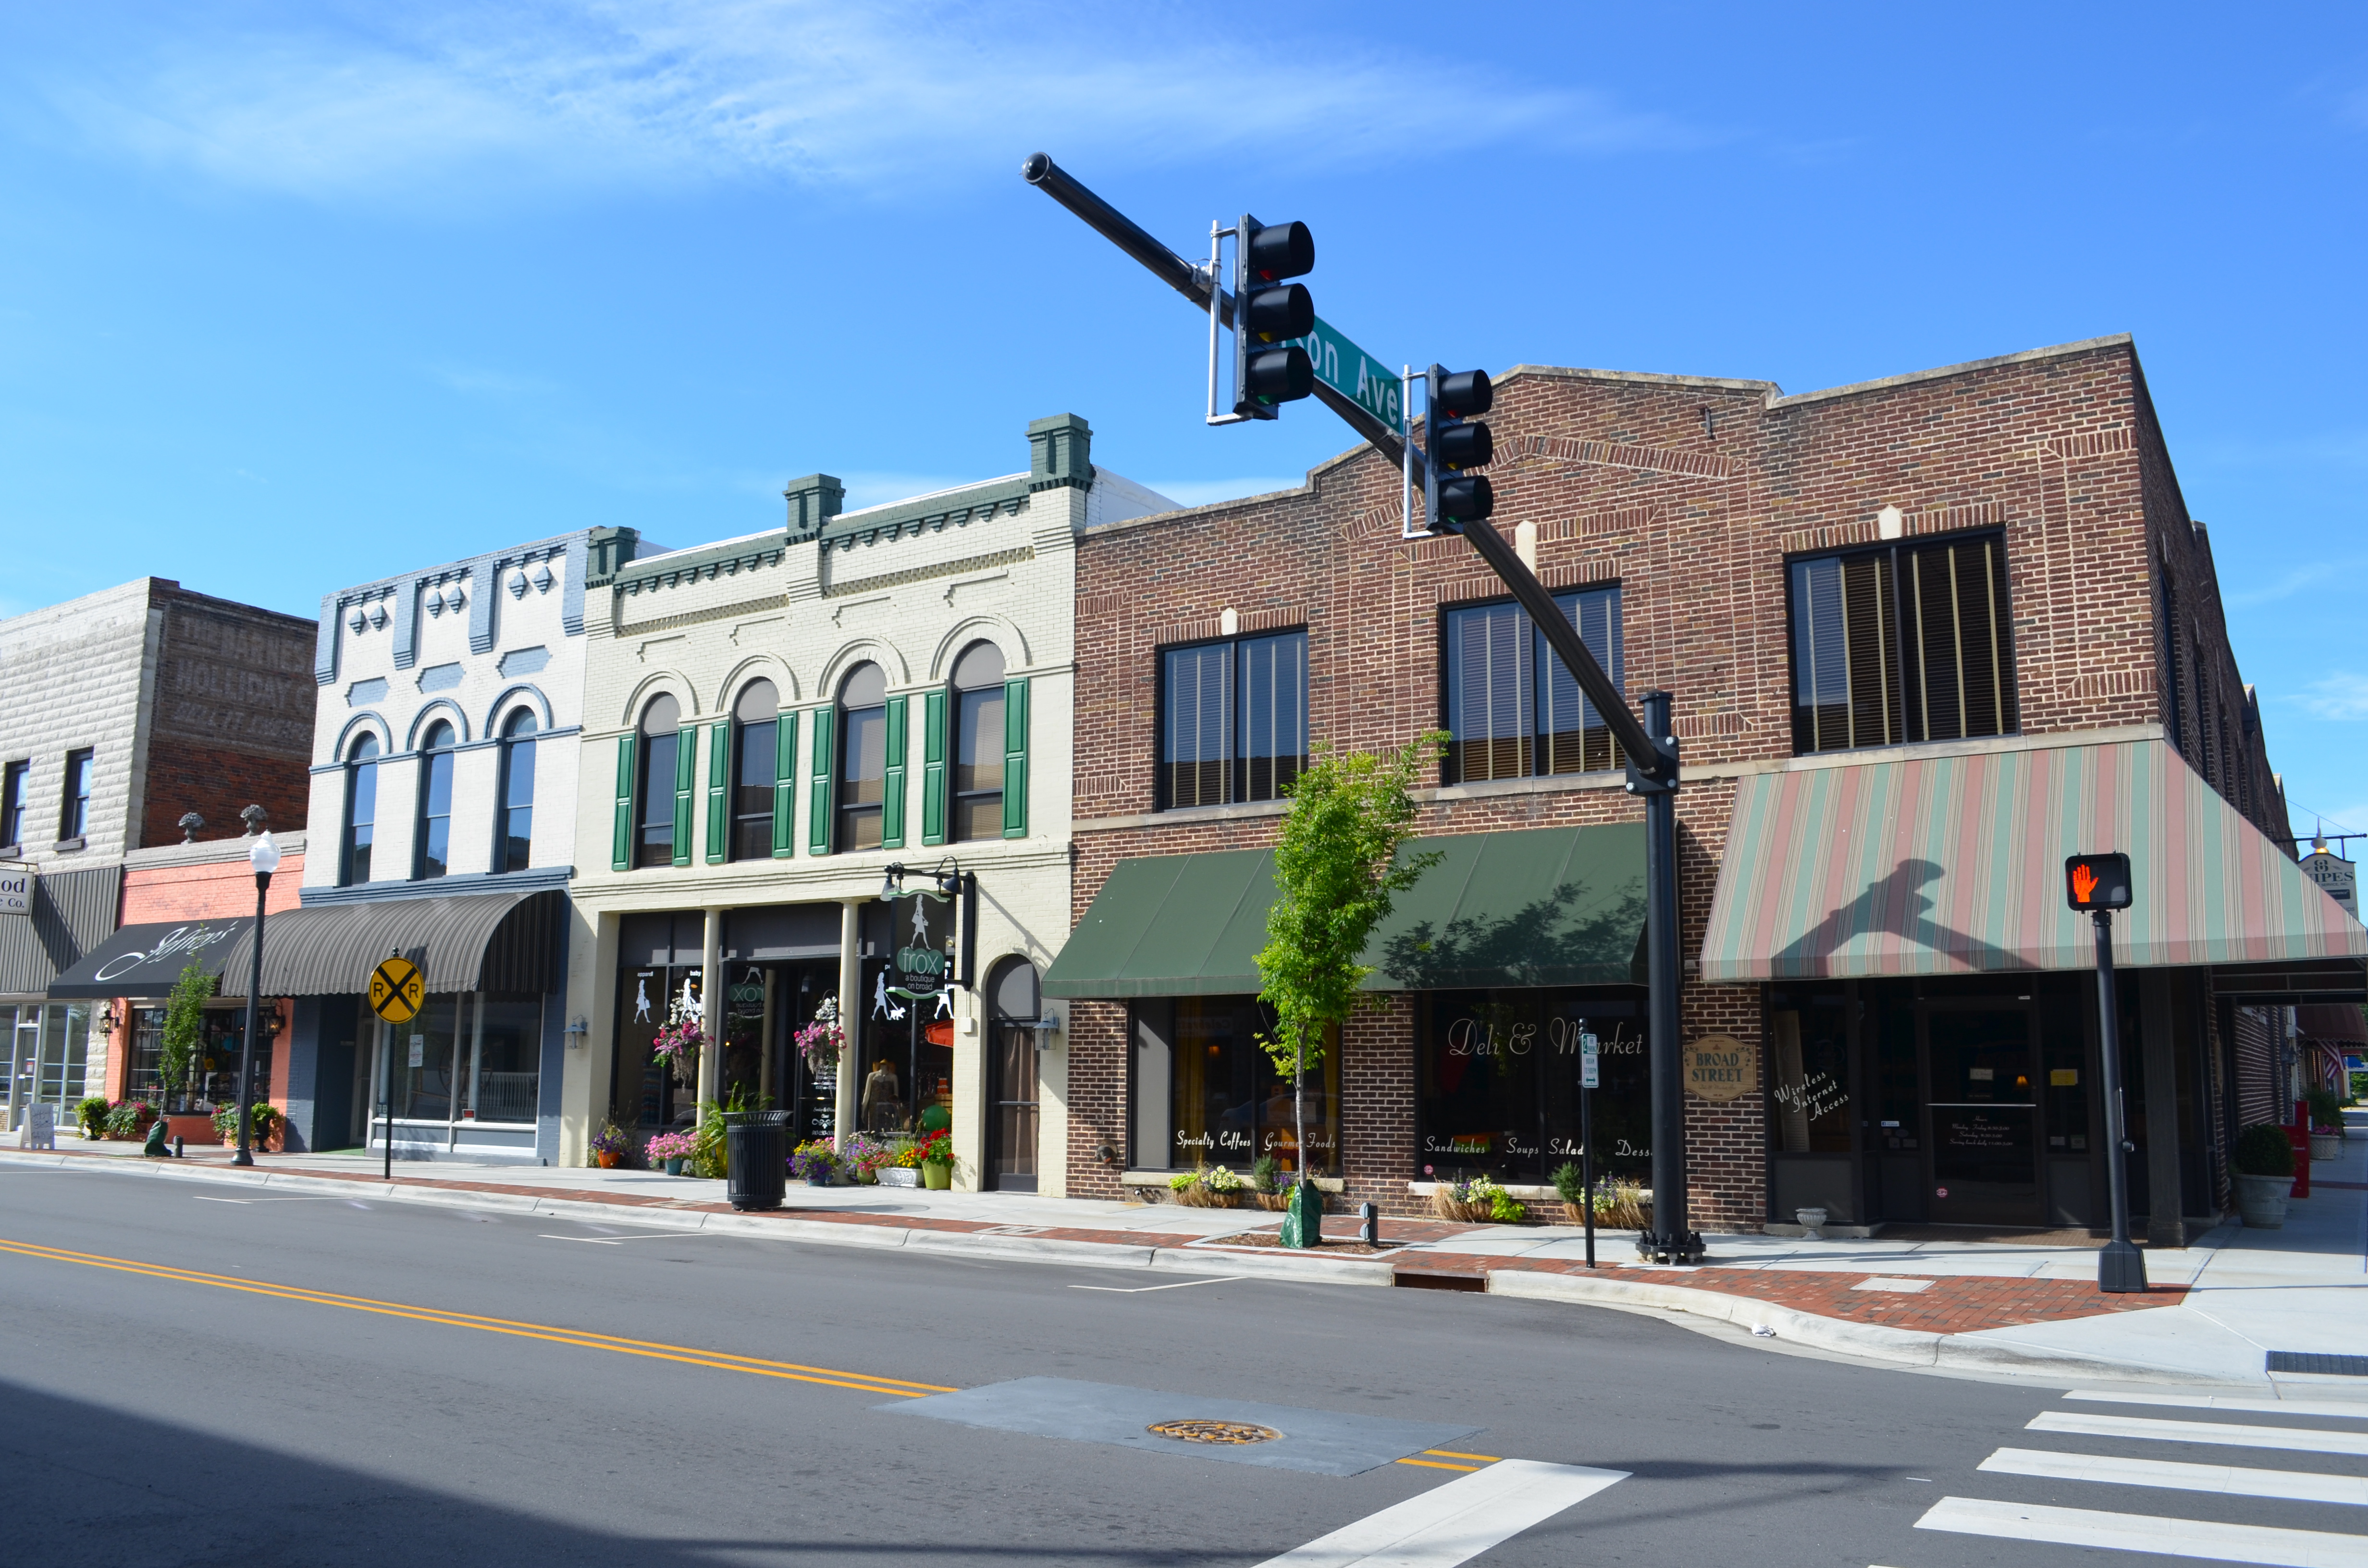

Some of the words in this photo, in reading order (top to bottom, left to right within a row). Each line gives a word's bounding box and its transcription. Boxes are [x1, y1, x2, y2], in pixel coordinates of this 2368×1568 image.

[1357, 355, 1398, 425] Ave
[0, 878, 25, 893] od
[8, 898, 25, 907] Co.
[903, 947, 938, 975] frox
[910, 974, 935, 982] boutique
[915, 982, 933, 990] broad
[373, 982, 384, 998] R
[408, 983, 419, 998] R
[1448, 1018, 1500, 1055] Deli
[1509, 1022, 1537, 1054] &
[1550, 1017, 1642, 1054] Mrket
[1583, 1038, 1587, 1051] 2
[1696, 1053, 1739, 1066] BROAD
[1692, 1068, 1743, 1082] STREET
[1774, 1072, 1826, 1103] Wireless
[1793, 1079, 1837, 1113] Internet
[1810, 1094, 1849, 1121] Access
[1176, 1130, 1214, 1149] Specialty
[1220, 1130, 1251, 1150] Coffees
[1264, 1132, 1300, 1151] Gourme
[1307, 1133, 1336, 1148] Foods
[1424, 1136, 1485, 1154] Sandwiches
[1506, 1137, 1539, 1158] Soups
[1615, 1139, 1653, 1157] Dess
